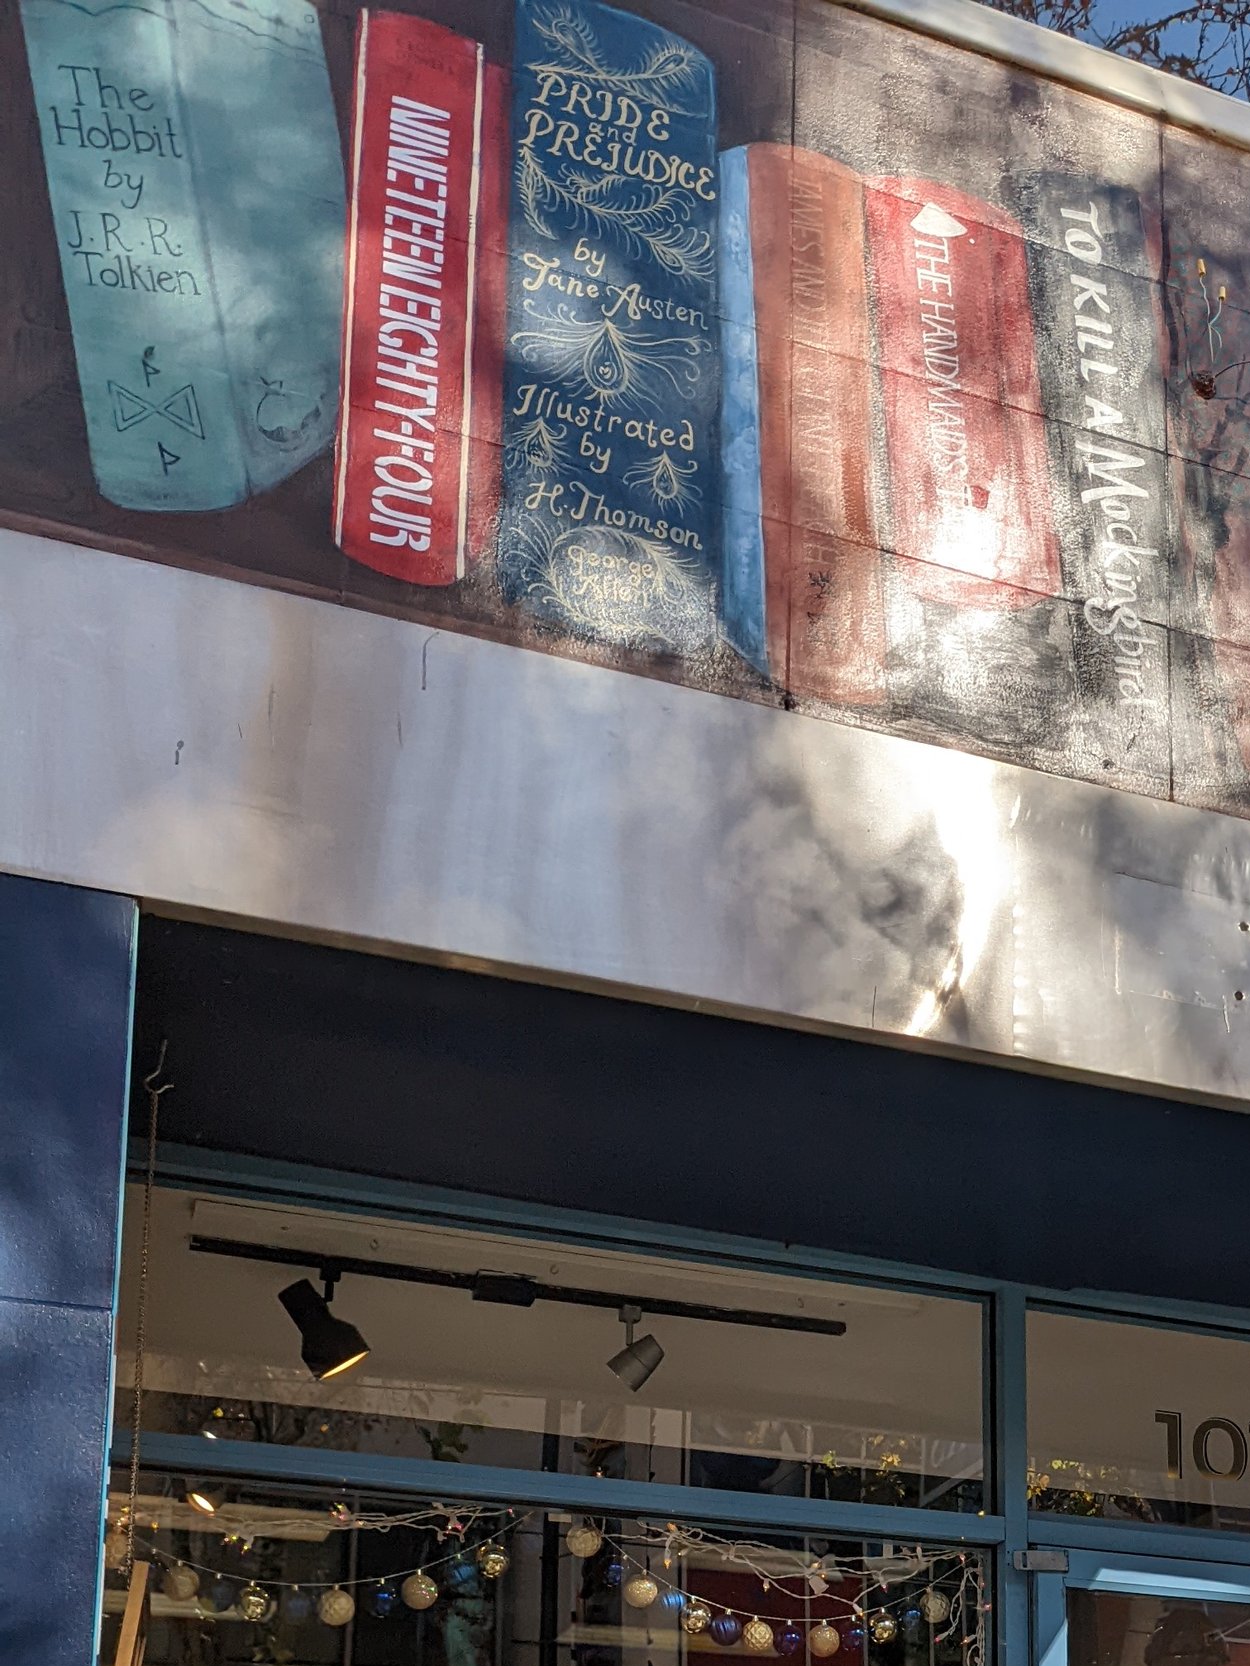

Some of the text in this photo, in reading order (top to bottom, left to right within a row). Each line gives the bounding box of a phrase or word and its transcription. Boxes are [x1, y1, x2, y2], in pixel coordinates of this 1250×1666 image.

[58, 64, 154, 113] The
[536, 70, 670, 141] PRIDE
[50, 106, 183, 158] Hobbit
[520, 111, 716, 200] PREJUDICE
[590, 120, 638, 145] and
[103, 159, 145, 208] by
[381, 95, 451, 296] NINETEEN
[73, 251, 200, 296] Tolkien
[574, 237, 605, 276] by
[914, 238, 952, 297] THE
[522, 252, 709, 330] Jane Austen
[369, 288, 441, 553] EIGHTY-FOUR
[513, 385, 695, 451] Illustrated
[580, 431, 610, 472] by
[1060, 201, 1159, 704] TO KILL A Mockingbird
[568, 545, 652, 583] George
